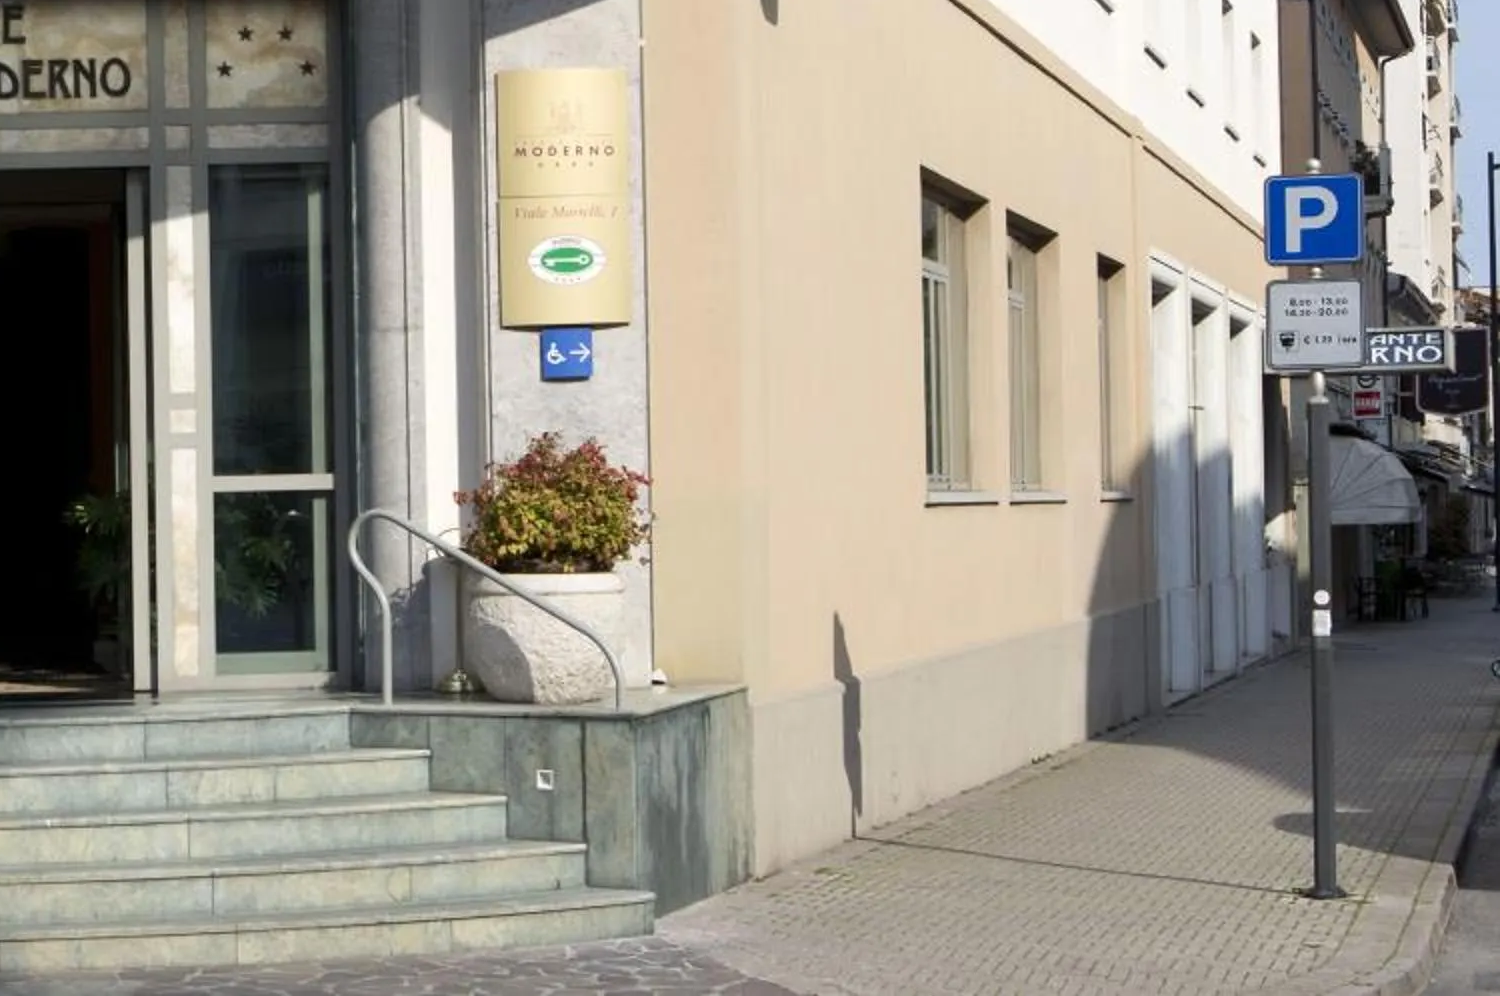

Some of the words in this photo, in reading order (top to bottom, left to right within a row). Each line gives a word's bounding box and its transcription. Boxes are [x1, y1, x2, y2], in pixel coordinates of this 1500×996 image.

[514, 145, 615, 157] MODERNO
[1284, 185, 1339, 254] P
[1369, 332, 1442, 345] ANTE
[1369, 345, 1443, 364] RNO
